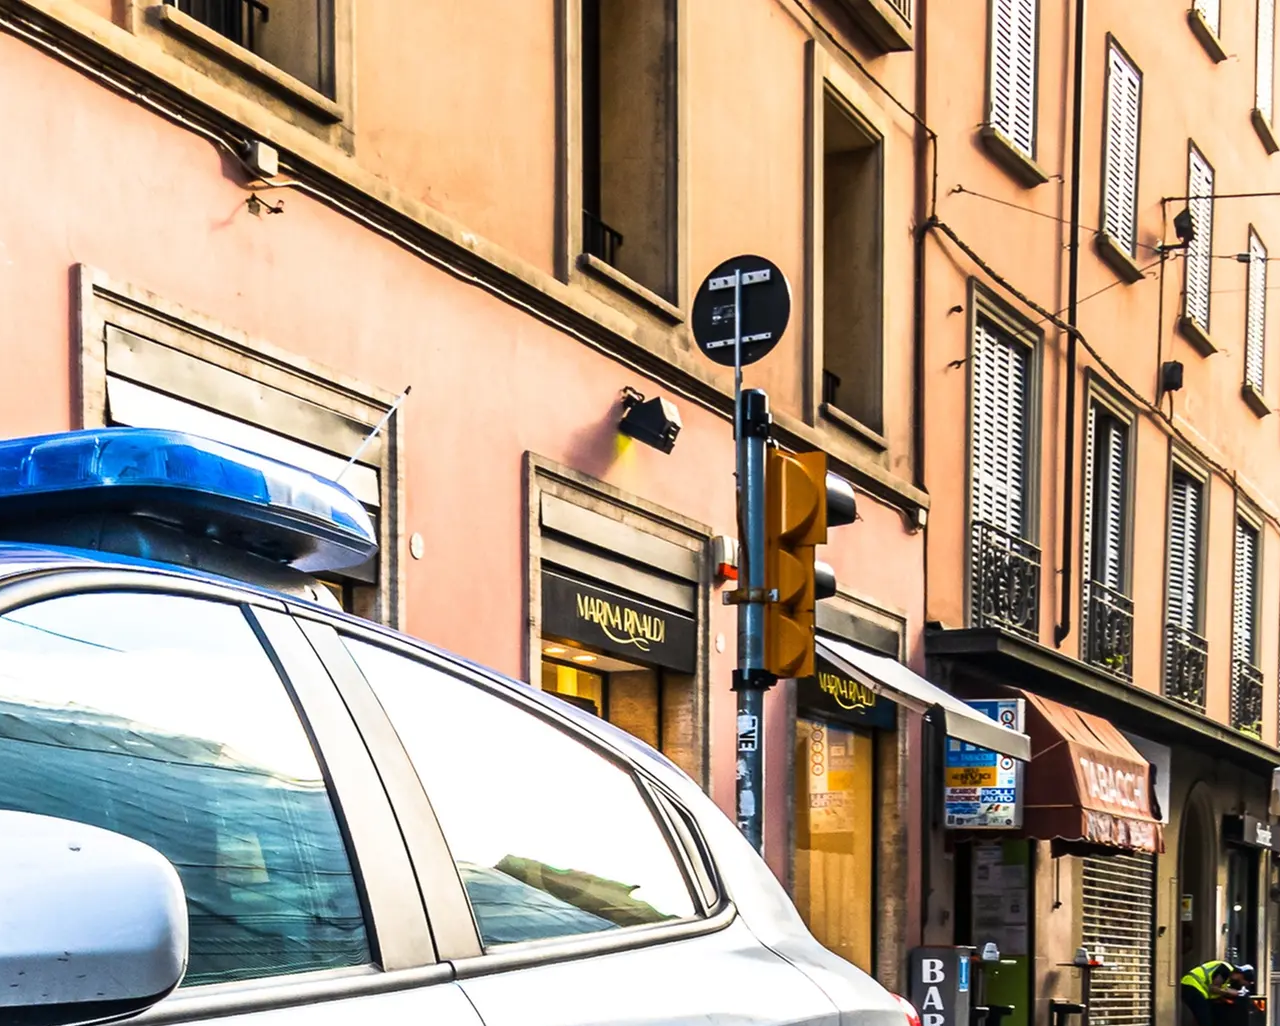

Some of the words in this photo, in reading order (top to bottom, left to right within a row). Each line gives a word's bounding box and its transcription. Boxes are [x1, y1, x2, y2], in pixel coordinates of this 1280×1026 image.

[576, 593, 623, 633] MARINA
[624, 607, 665, 643] RINALDI
[818, 671, 848, 699] MARINA
[981, 788, 1015, 796] BOLLI
[1079, 757, 1145, 812] TABACCHI
